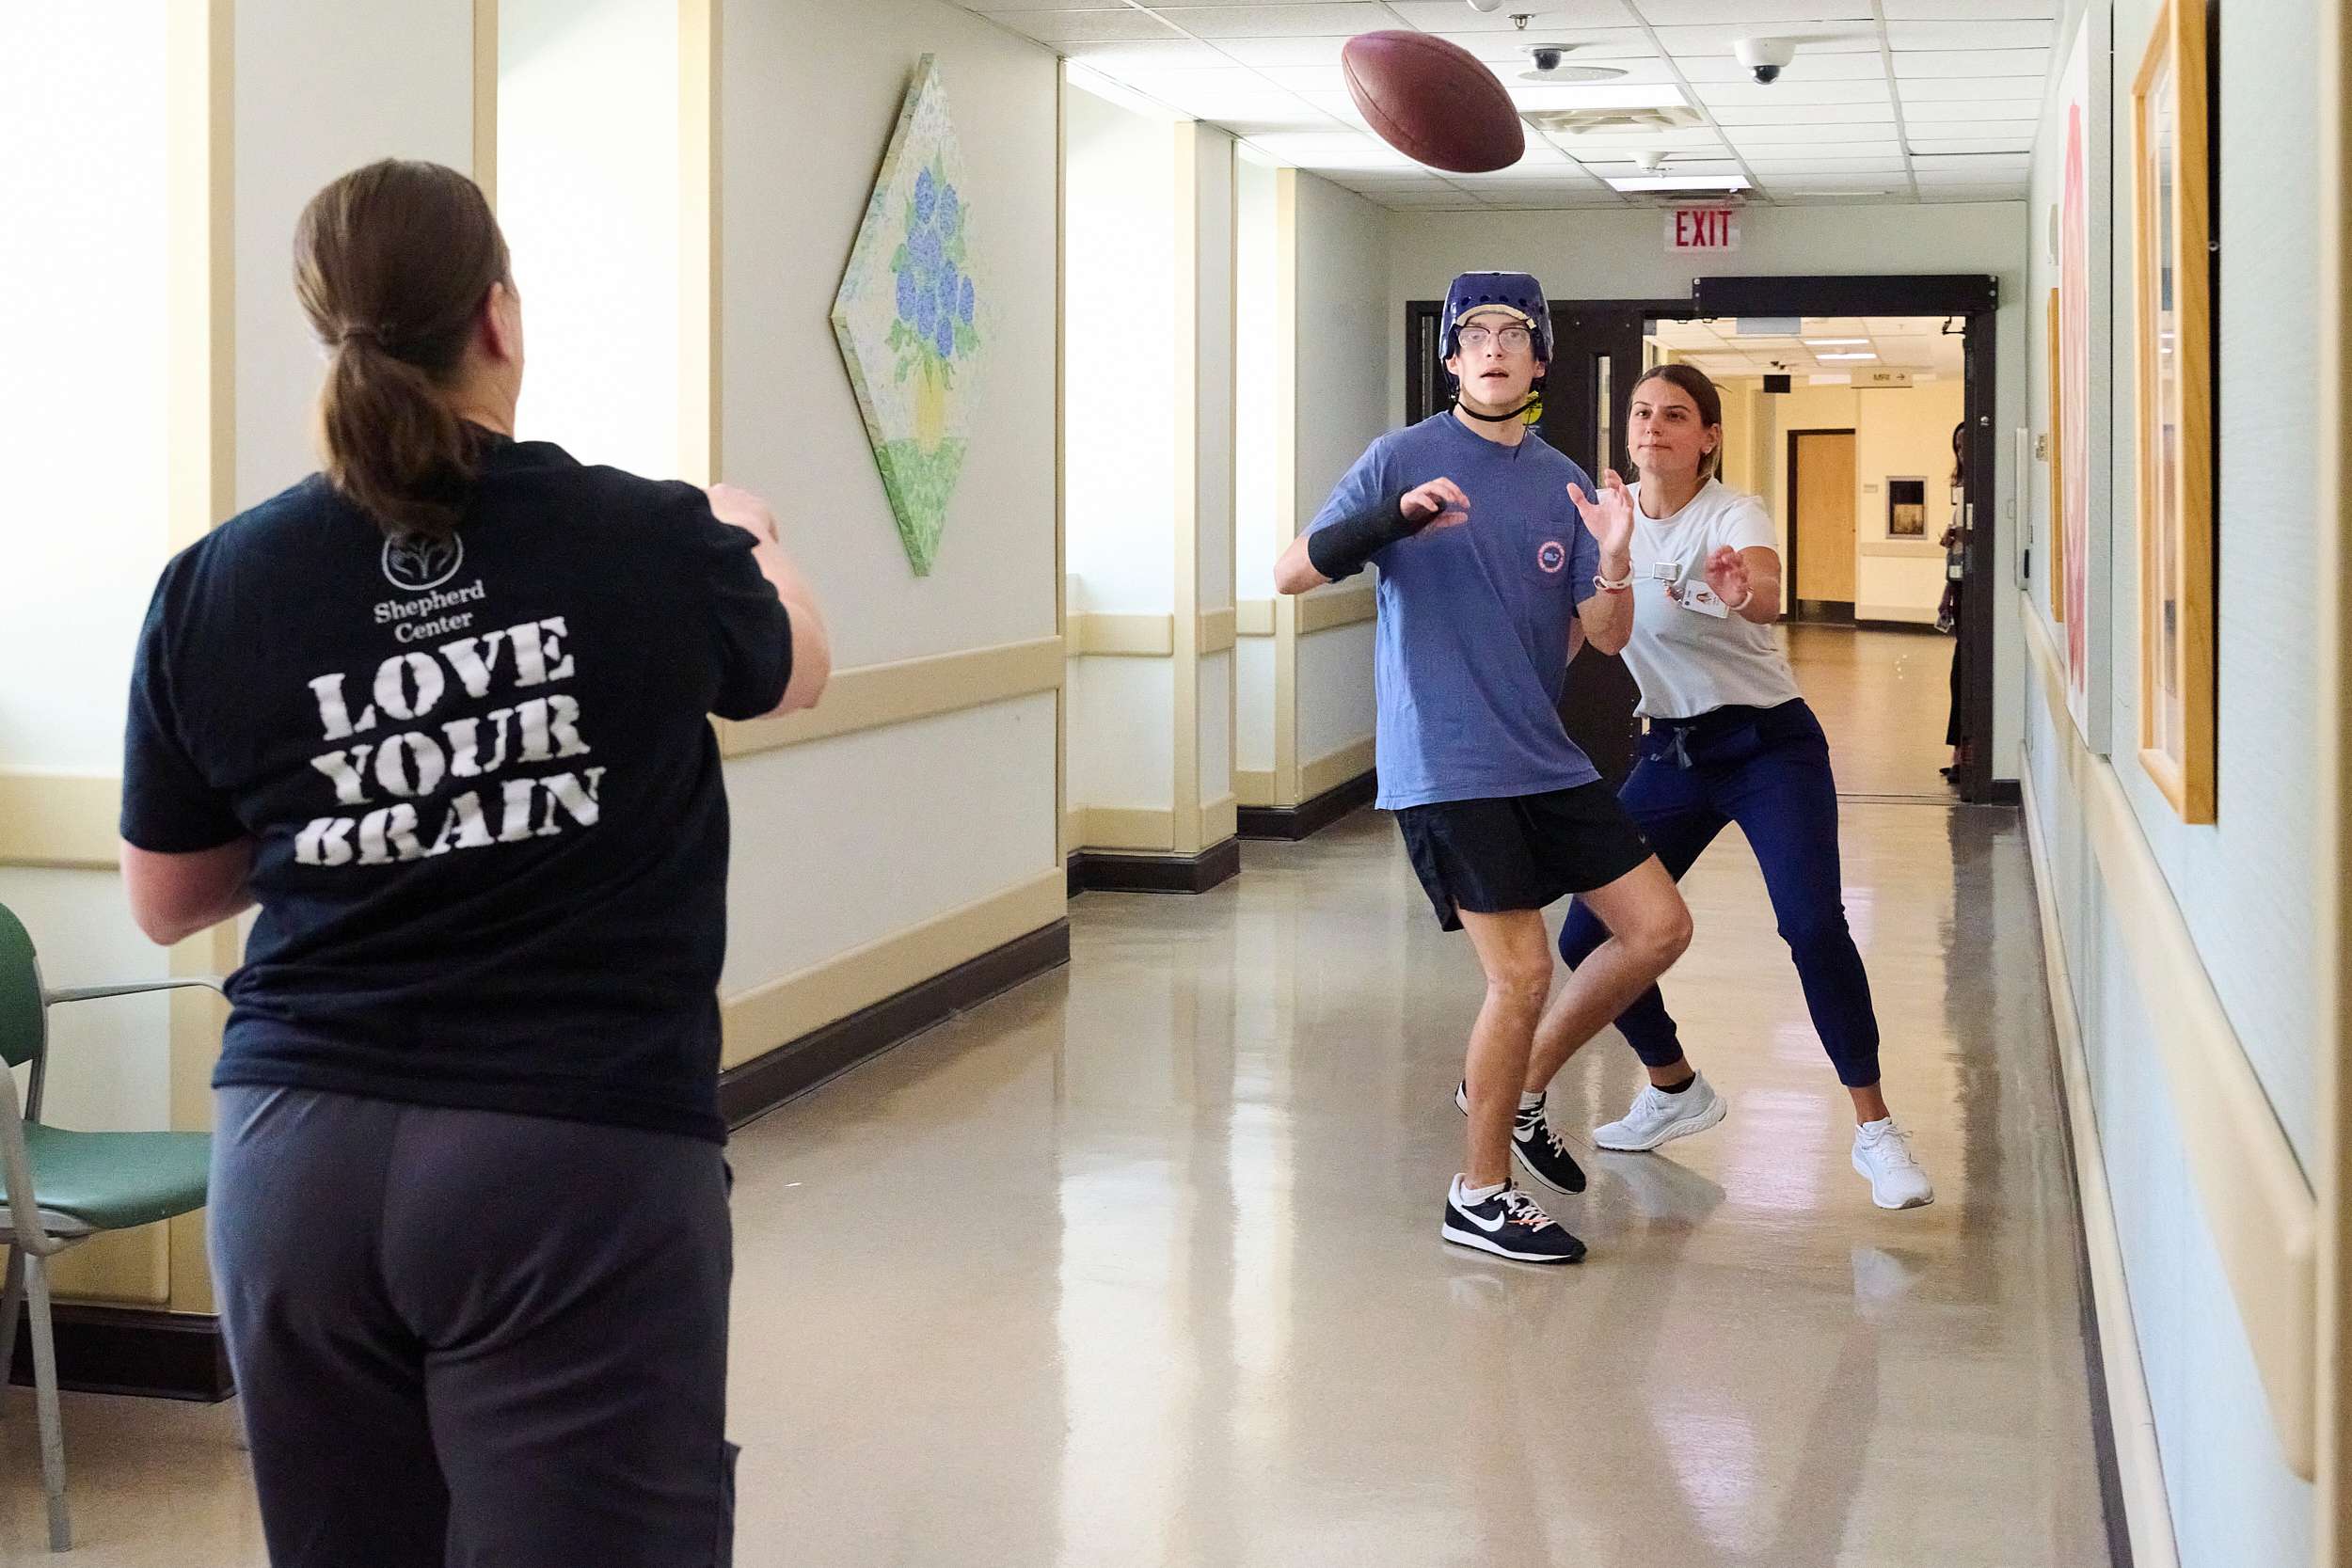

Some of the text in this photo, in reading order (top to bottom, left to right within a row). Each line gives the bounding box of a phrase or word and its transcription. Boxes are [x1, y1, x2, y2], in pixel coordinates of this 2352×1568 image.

[1677, 211, 1733, 246] EXIT
[373, 579, 485, 624] Shepherd
[395, 613, 473, 643] Center
[308, 616, 575, 741] LOVE
[310, 694, 591, 805] YOUR
[294, 767, 607, 866] BRAIN
